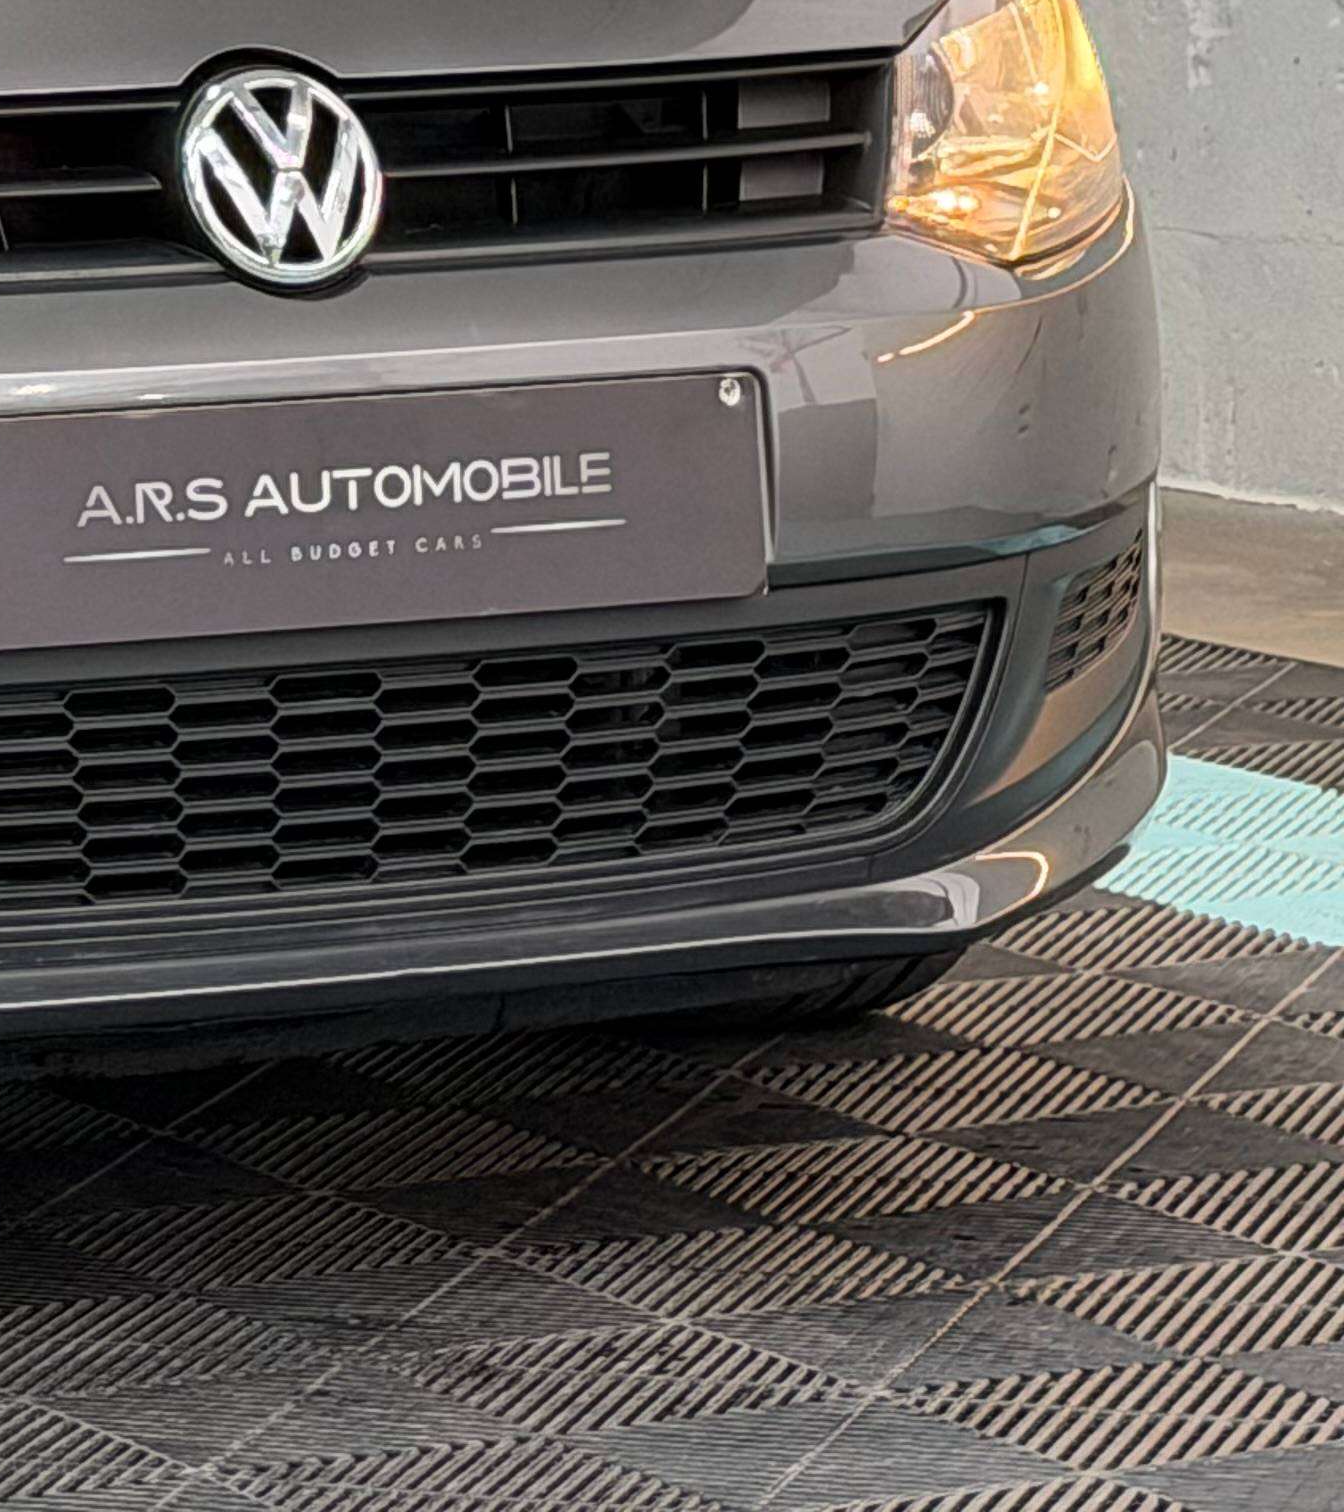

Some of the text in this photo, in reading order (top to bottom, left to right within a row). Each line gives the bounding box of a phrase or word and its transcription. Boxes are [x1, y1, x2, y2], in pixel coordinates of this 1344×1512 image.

[183, 70, 383, 284] VW
[77, 452, 612, 527] A.R.S AUTOMOBILE
[223, 534, 482, 568] ALL BUDGET CARS
